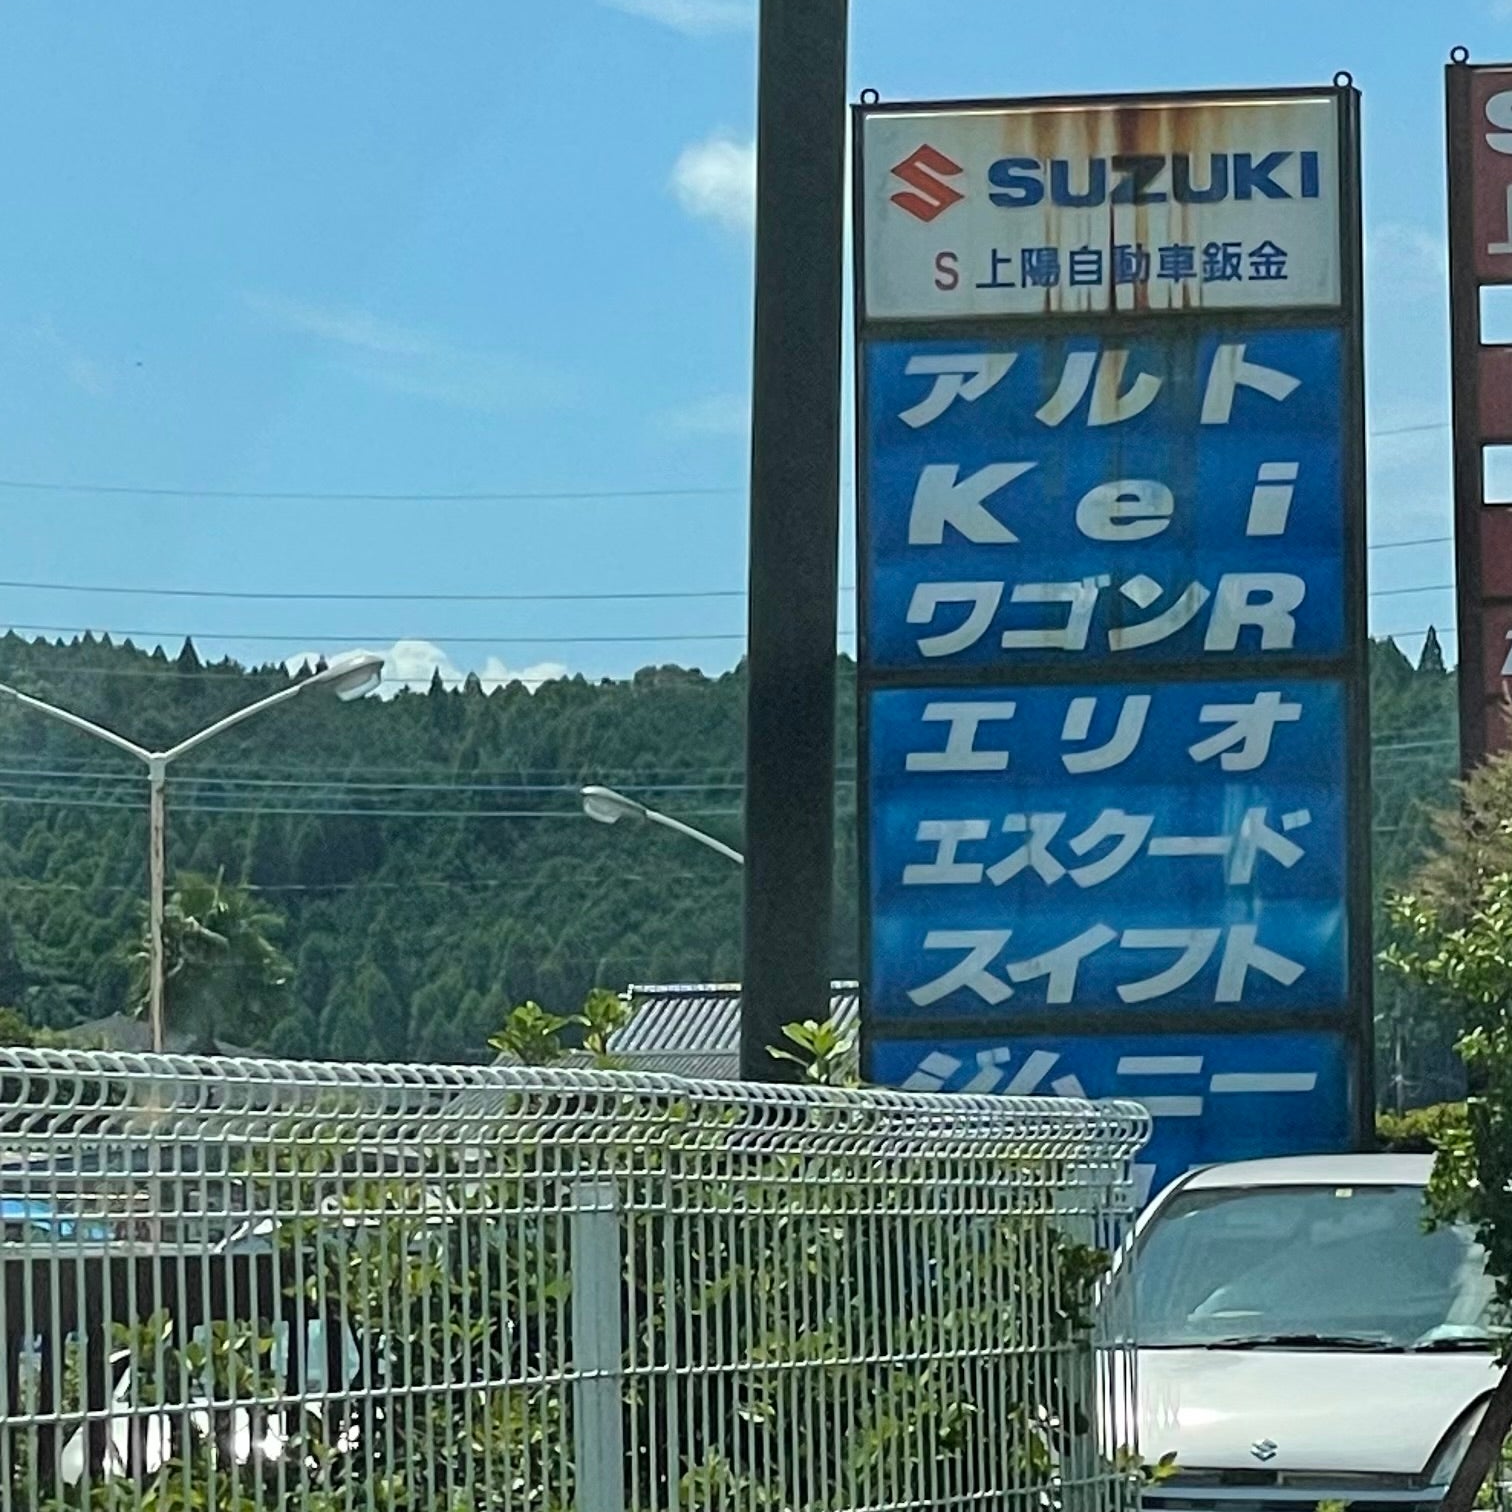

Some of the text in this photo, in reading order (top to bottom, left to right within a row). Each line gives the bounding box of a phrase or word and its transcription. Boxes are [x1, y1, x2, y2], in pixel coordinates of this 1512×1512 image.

[987, 150, 1320, 208] SUZUKI
[934, 251, 960, 291] S
[975, 240, 1289, 289] 上陽自動車鈑金
[897, 343, 1302, 429] アルト
[908, 461, 1300, 545] Kei
[905, 572, 1306, 658] ワゴンR
[905, 691, 1302, 774] エリオ
[902, 807, 1312, 888] エスクード
[906, 923, 1306, 1007] スイフト
